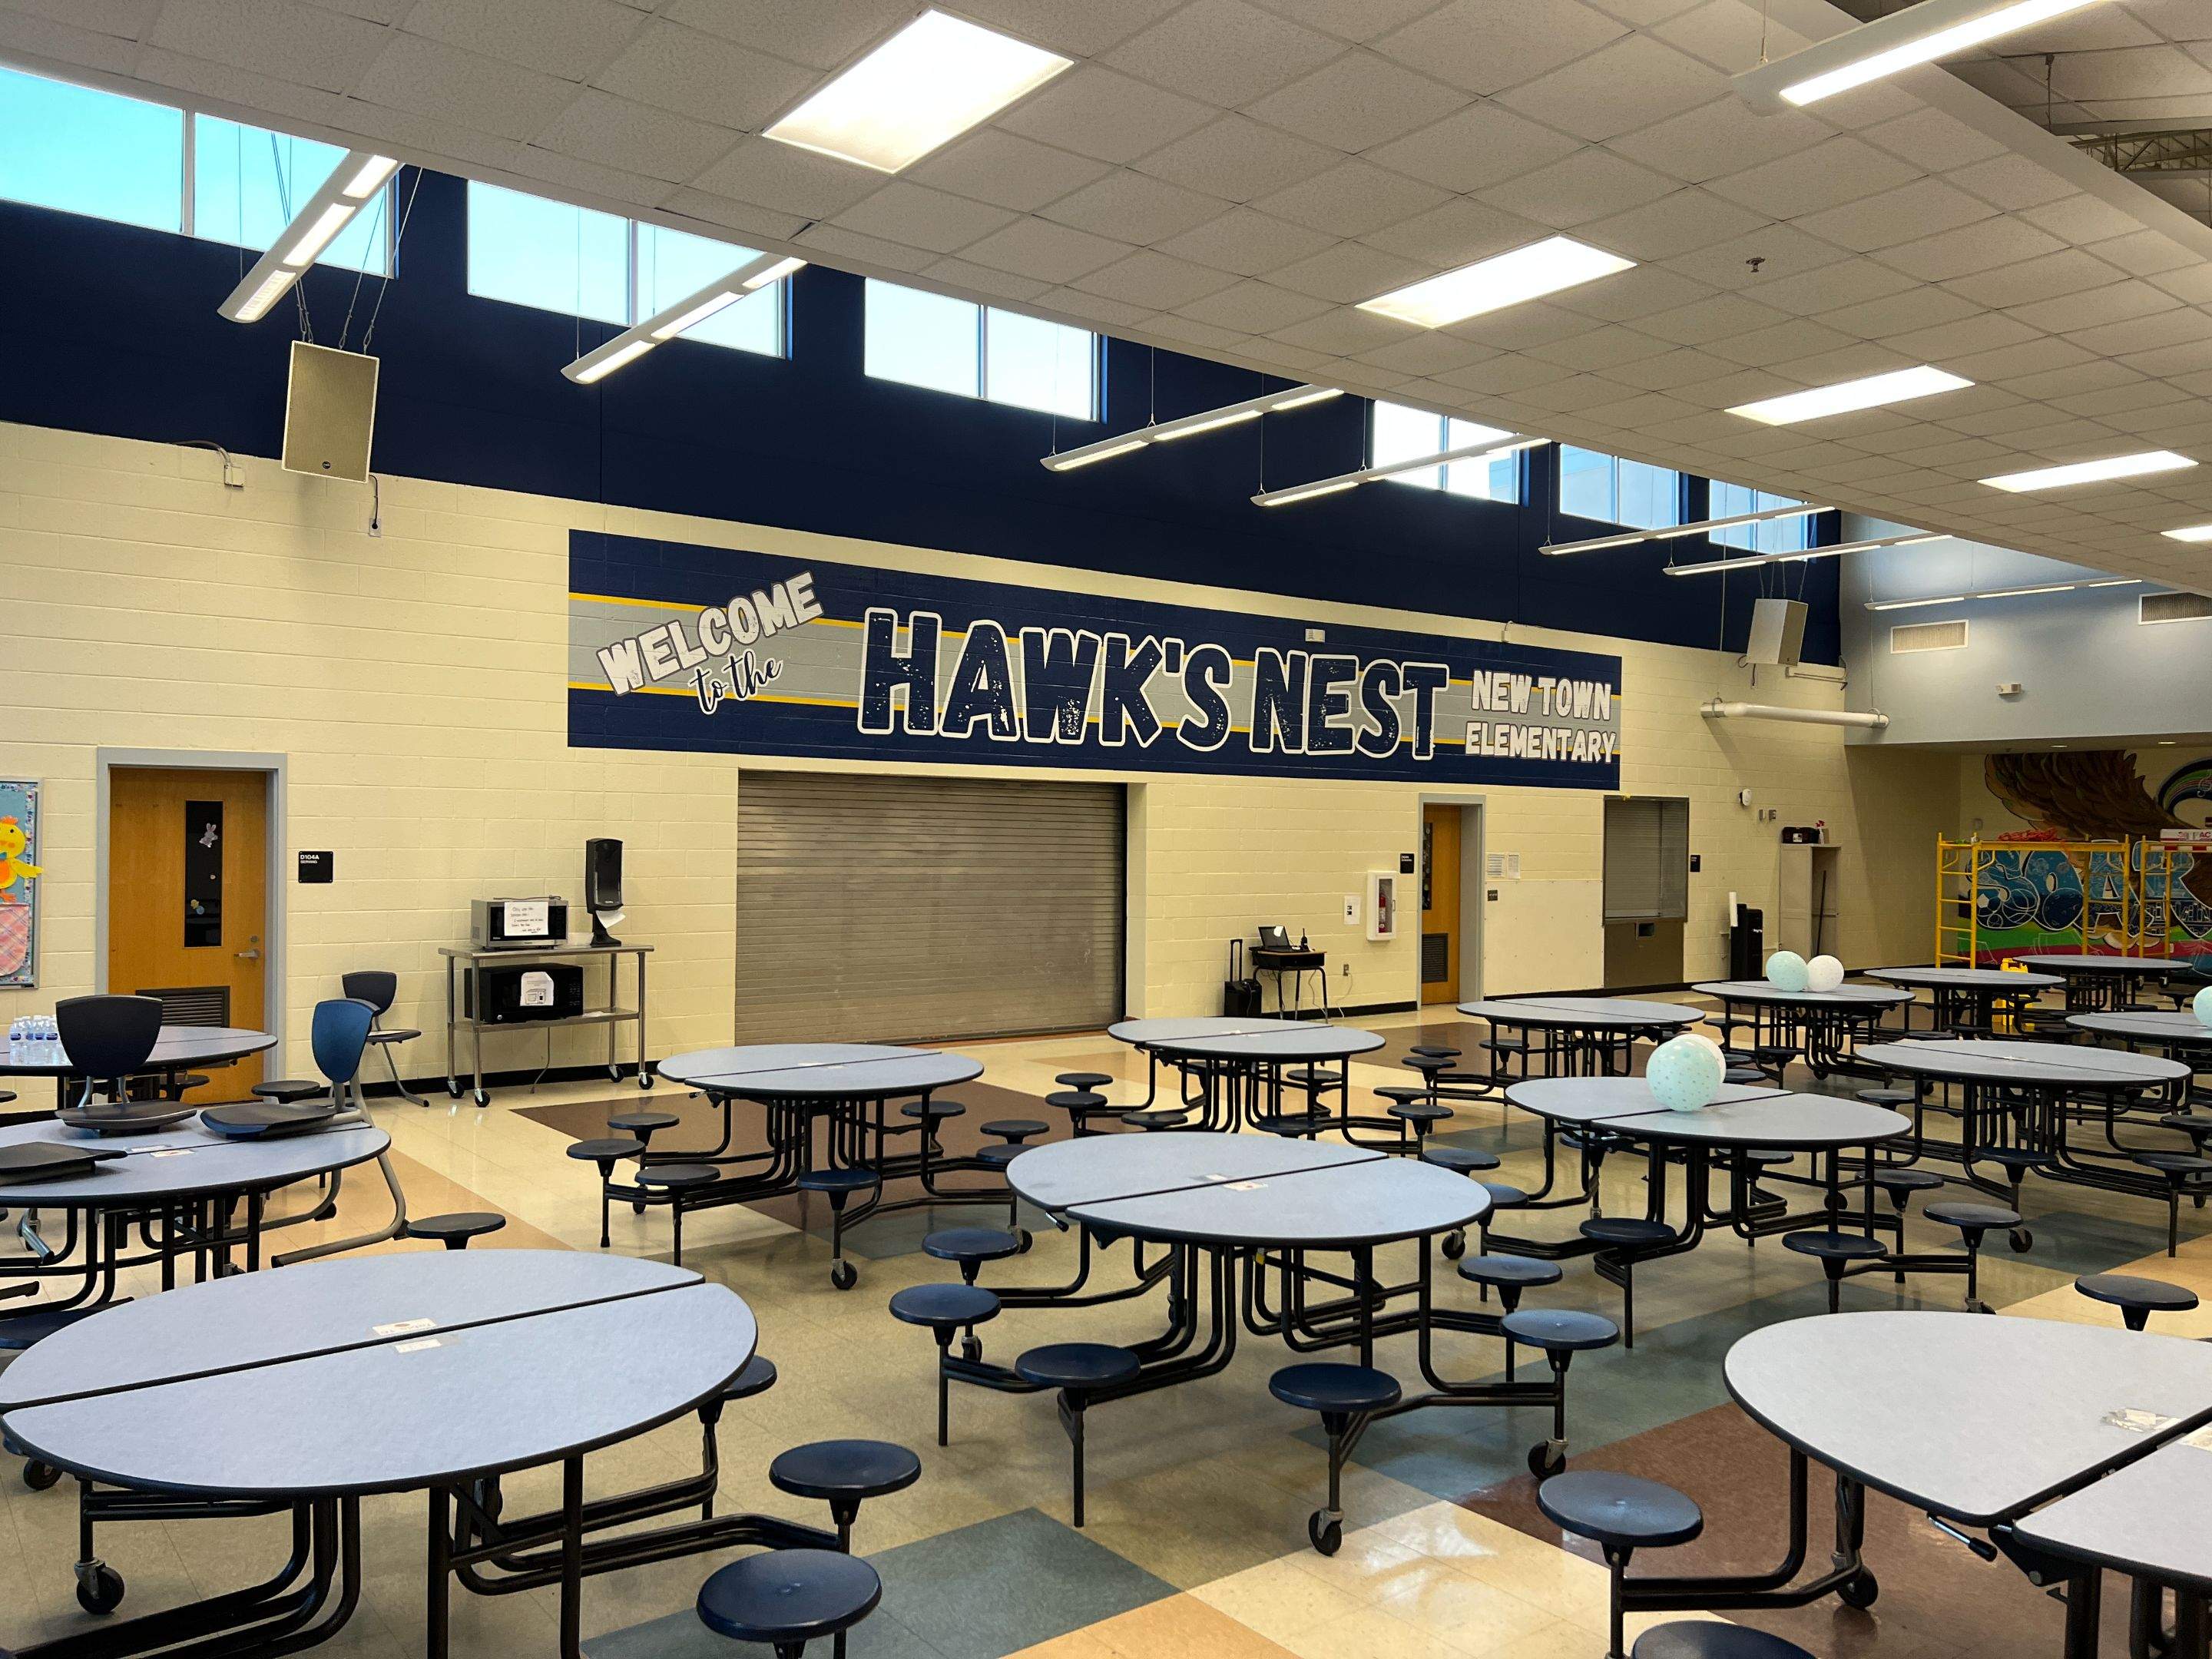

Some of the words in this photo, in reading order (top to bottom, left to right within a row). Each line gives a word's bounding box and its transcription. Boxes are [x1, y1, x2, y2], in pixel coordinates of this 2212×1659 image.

[596, 571, 823, 697] WELCOME
[688, 666, 730, 715] to
[723, 647, 783, 702] the
[857, 608, 1233, 751] HAWK'S
[1249, 647, 1450, 760] NEST
[1471, 669, 1532, 714] NEW
[1538, 676, 1611, 721] TOWN
[1465, 720, 1617, 764] ELEMENTARY
